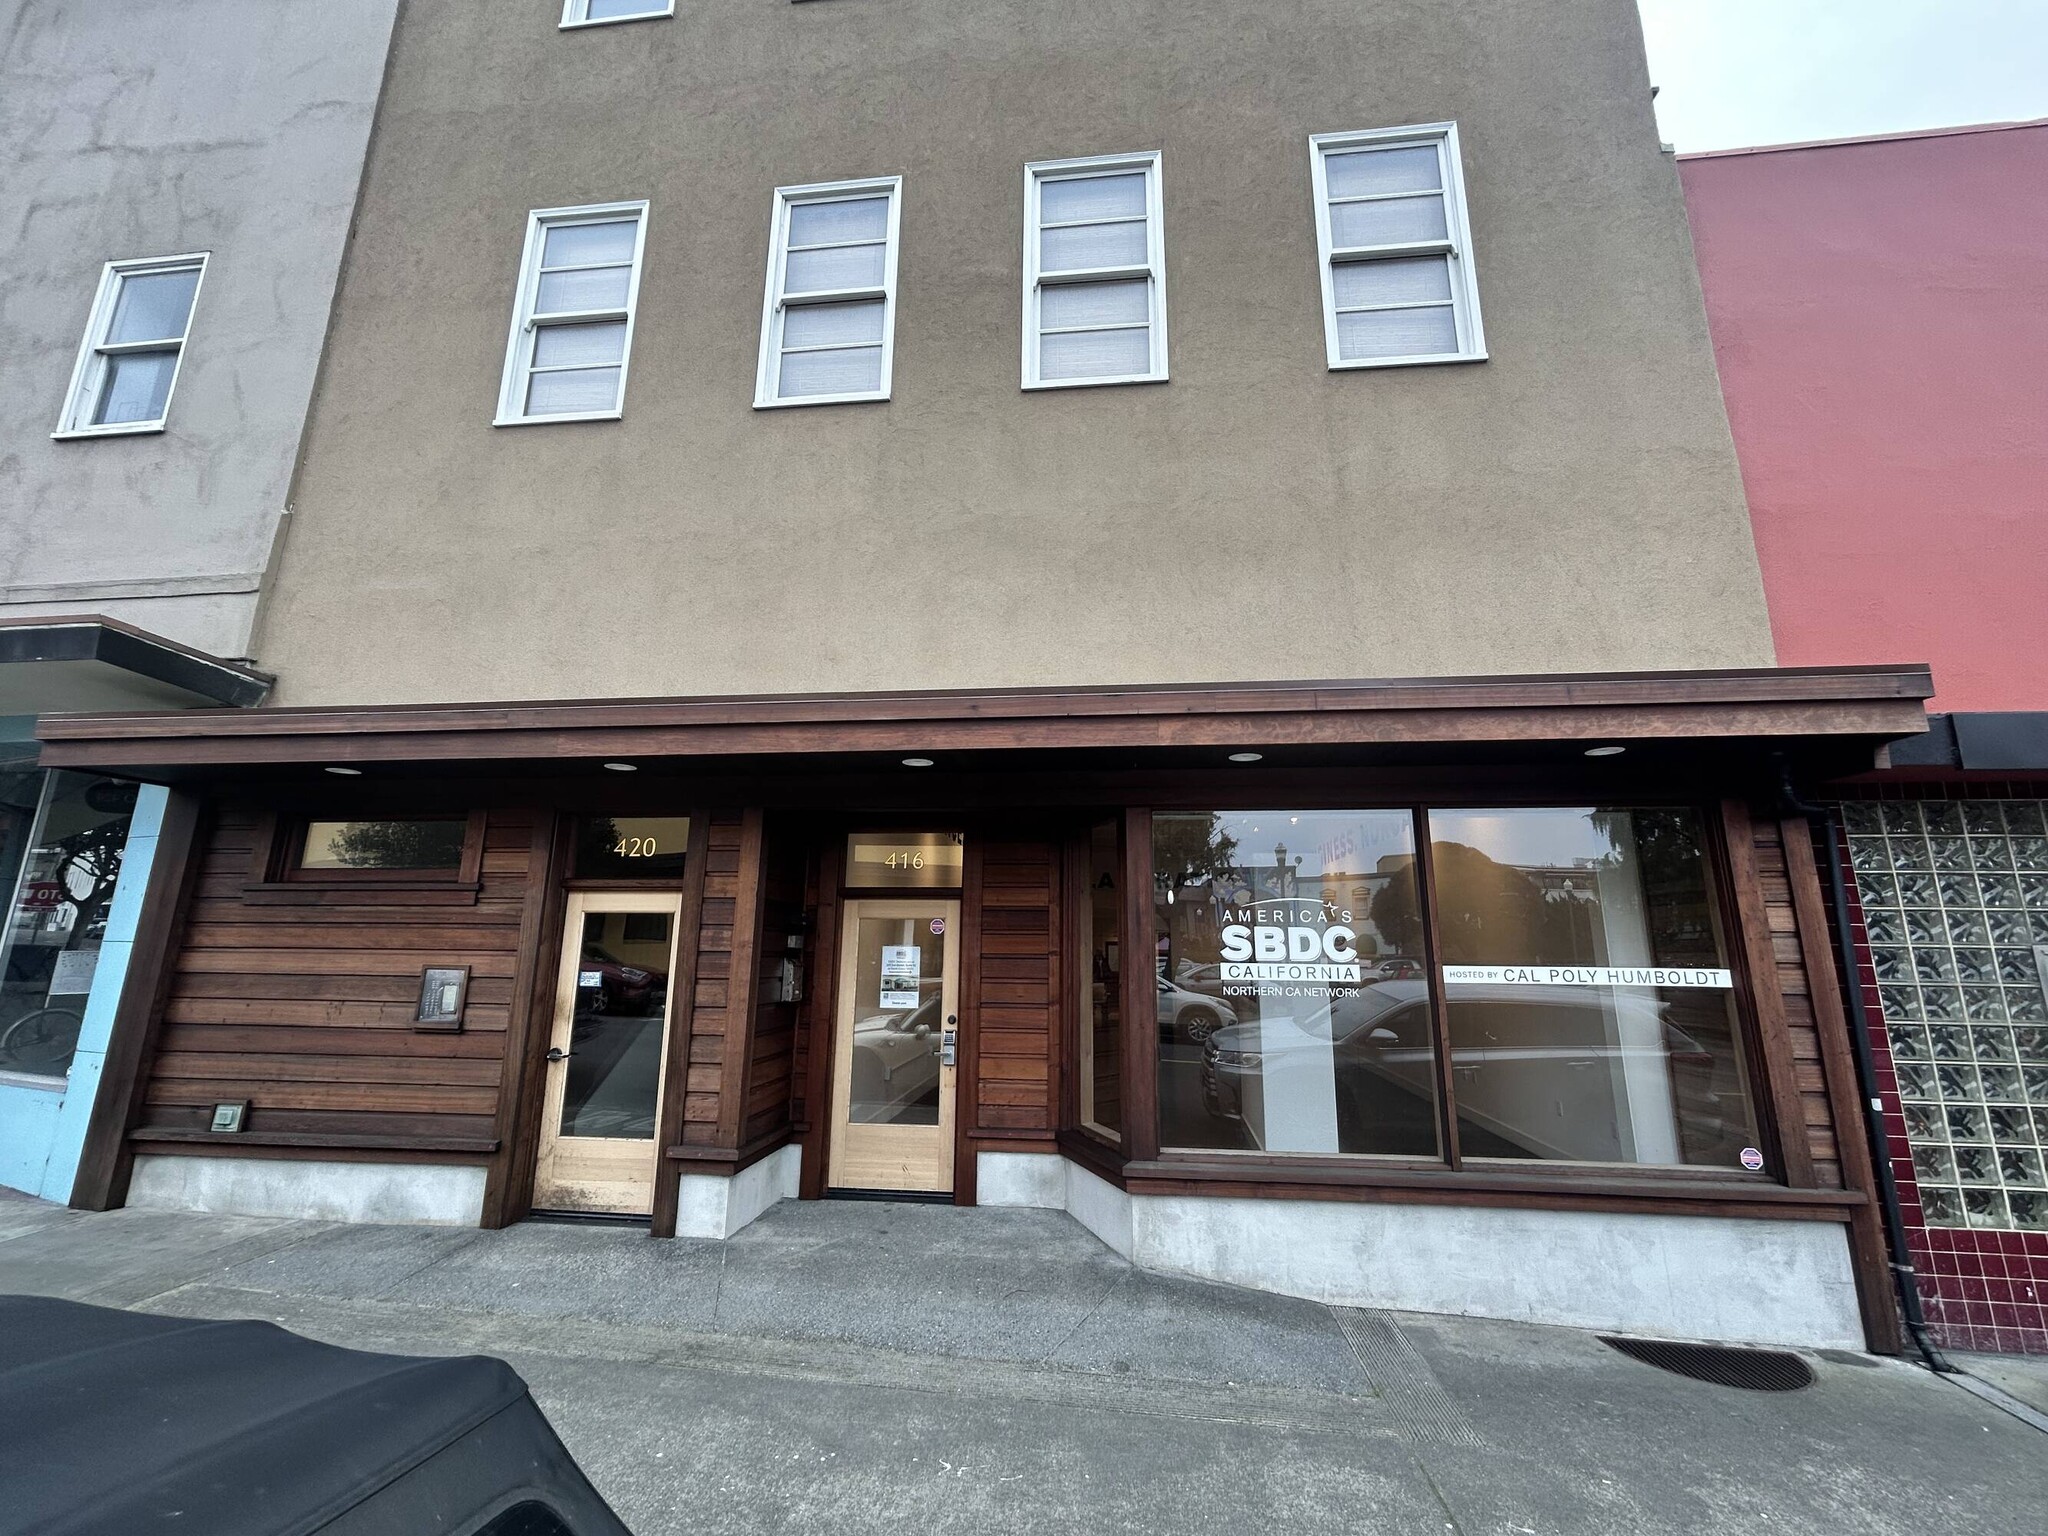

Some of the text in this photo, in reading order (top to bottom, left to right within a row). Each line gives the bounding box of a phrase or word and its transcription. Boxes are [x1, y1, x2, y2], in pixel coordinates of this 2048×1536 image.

[613, 837, 656, 857] 420
[884, 852, 924, 869] 416
[1220, 924, 1358, 963] SBDC
[1228, 965, 1355, 980] CALIFORNIA
[1449, 969, 1719, 985] HOSTED BY CAL POLY HUMBOLDT
[1222, 986, 1360, 998] NORTHERN CA NETWORK
